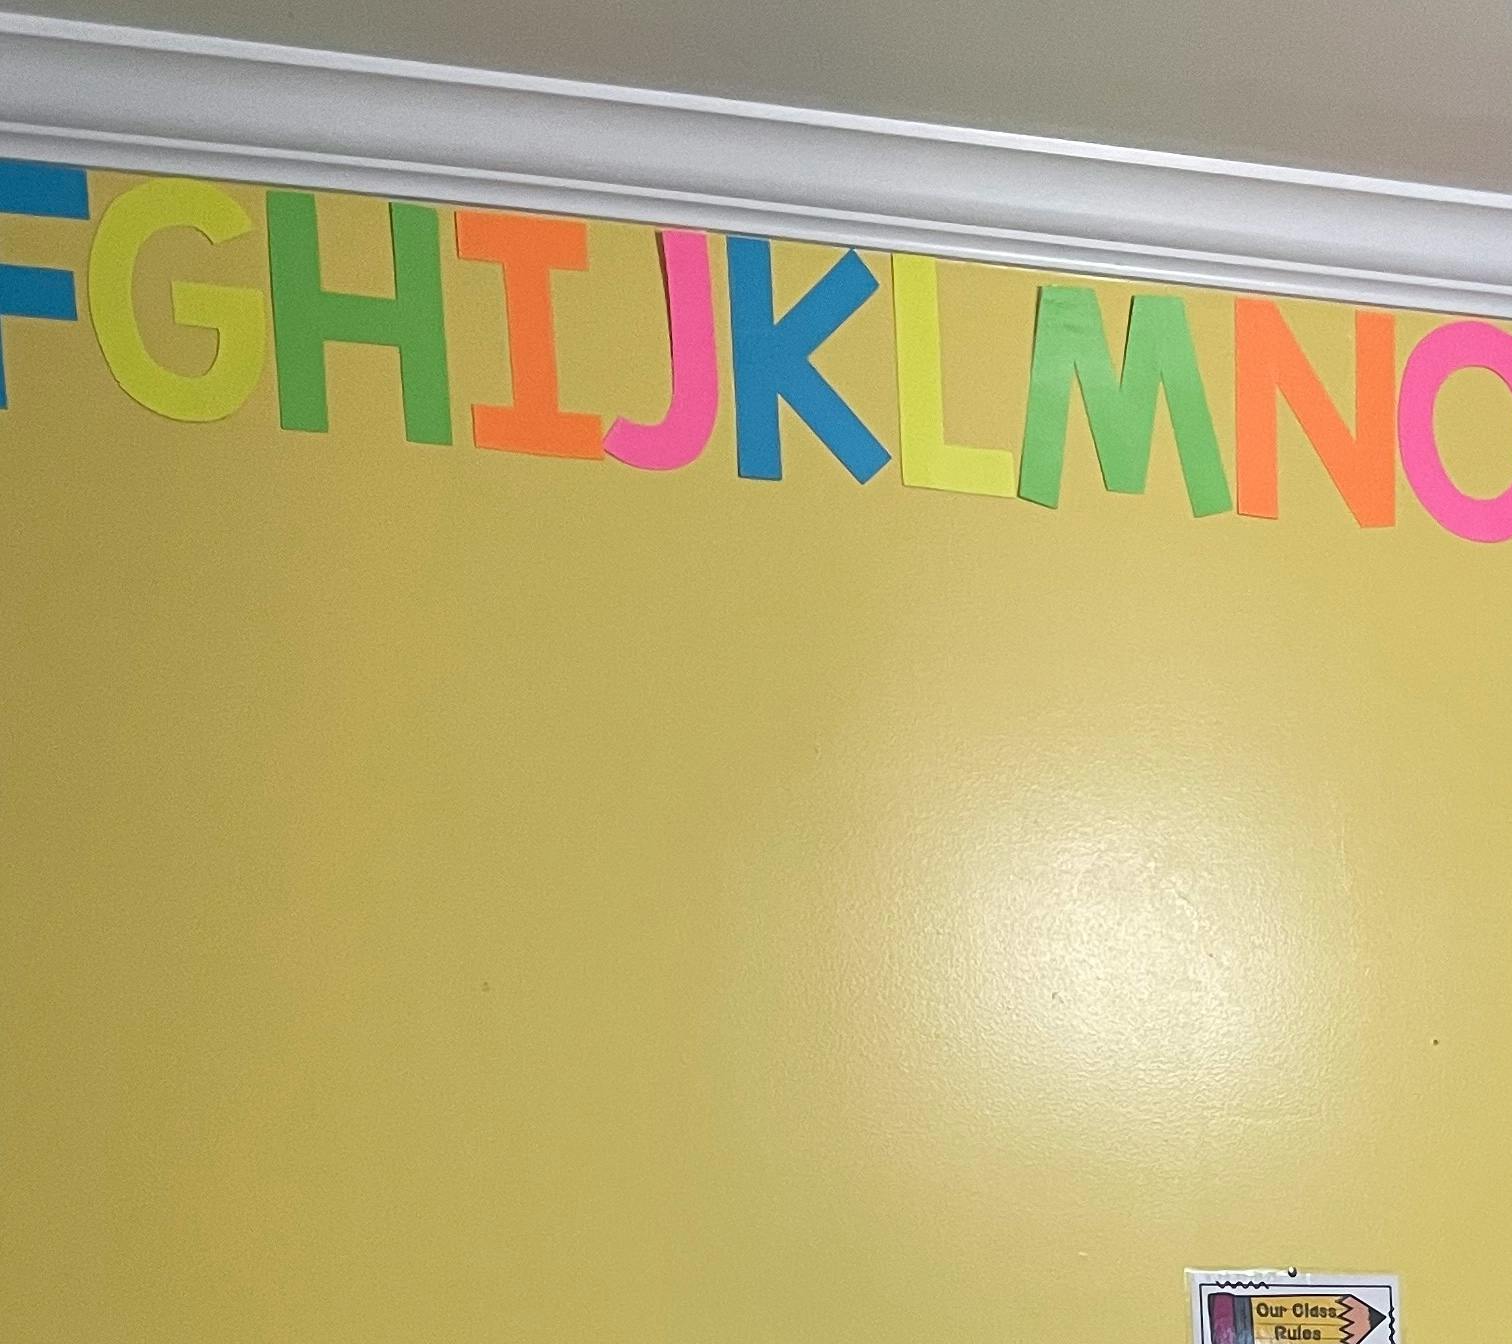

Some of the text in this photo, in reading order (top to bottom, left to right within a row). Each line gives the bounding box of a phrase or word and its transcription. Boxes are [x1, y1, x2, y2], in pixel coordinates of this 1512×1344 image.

[1256, 1303, 1337, 1318] Our Class
[1274, 1325, 1322, 1341] Rules
